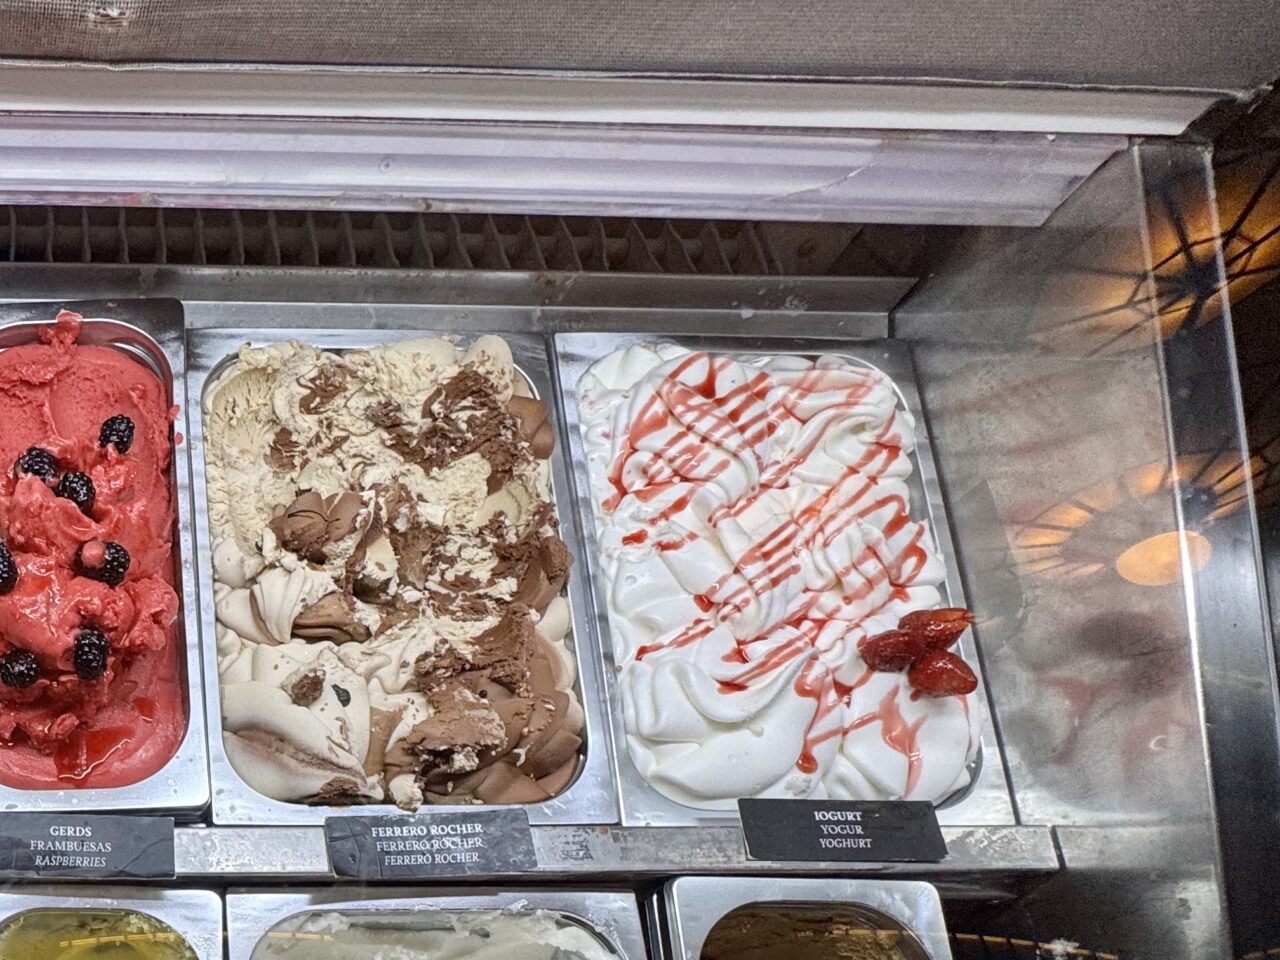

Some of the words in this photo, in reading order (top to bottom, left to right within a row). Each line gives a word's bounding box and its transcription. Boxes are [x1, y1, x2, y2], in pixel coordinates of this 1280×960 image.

[813, 810, 863, 822] IOGURT
[49, 825, 93, 837] GERDS
[371, 826, 428, 838] FERRERO
[430, 823, 484, 836] ROCHER
[820, 824, 865, 836] YOGUR
[30, 839, 112, 852] FRAMBUESAS
[431, 837, 483, 850] ROCHER
[819, 838, 873, 849] YOGHURT
[35, 855, 107, 867] RASPBERRIES
[435, 851, 480, 864] ROCHER
